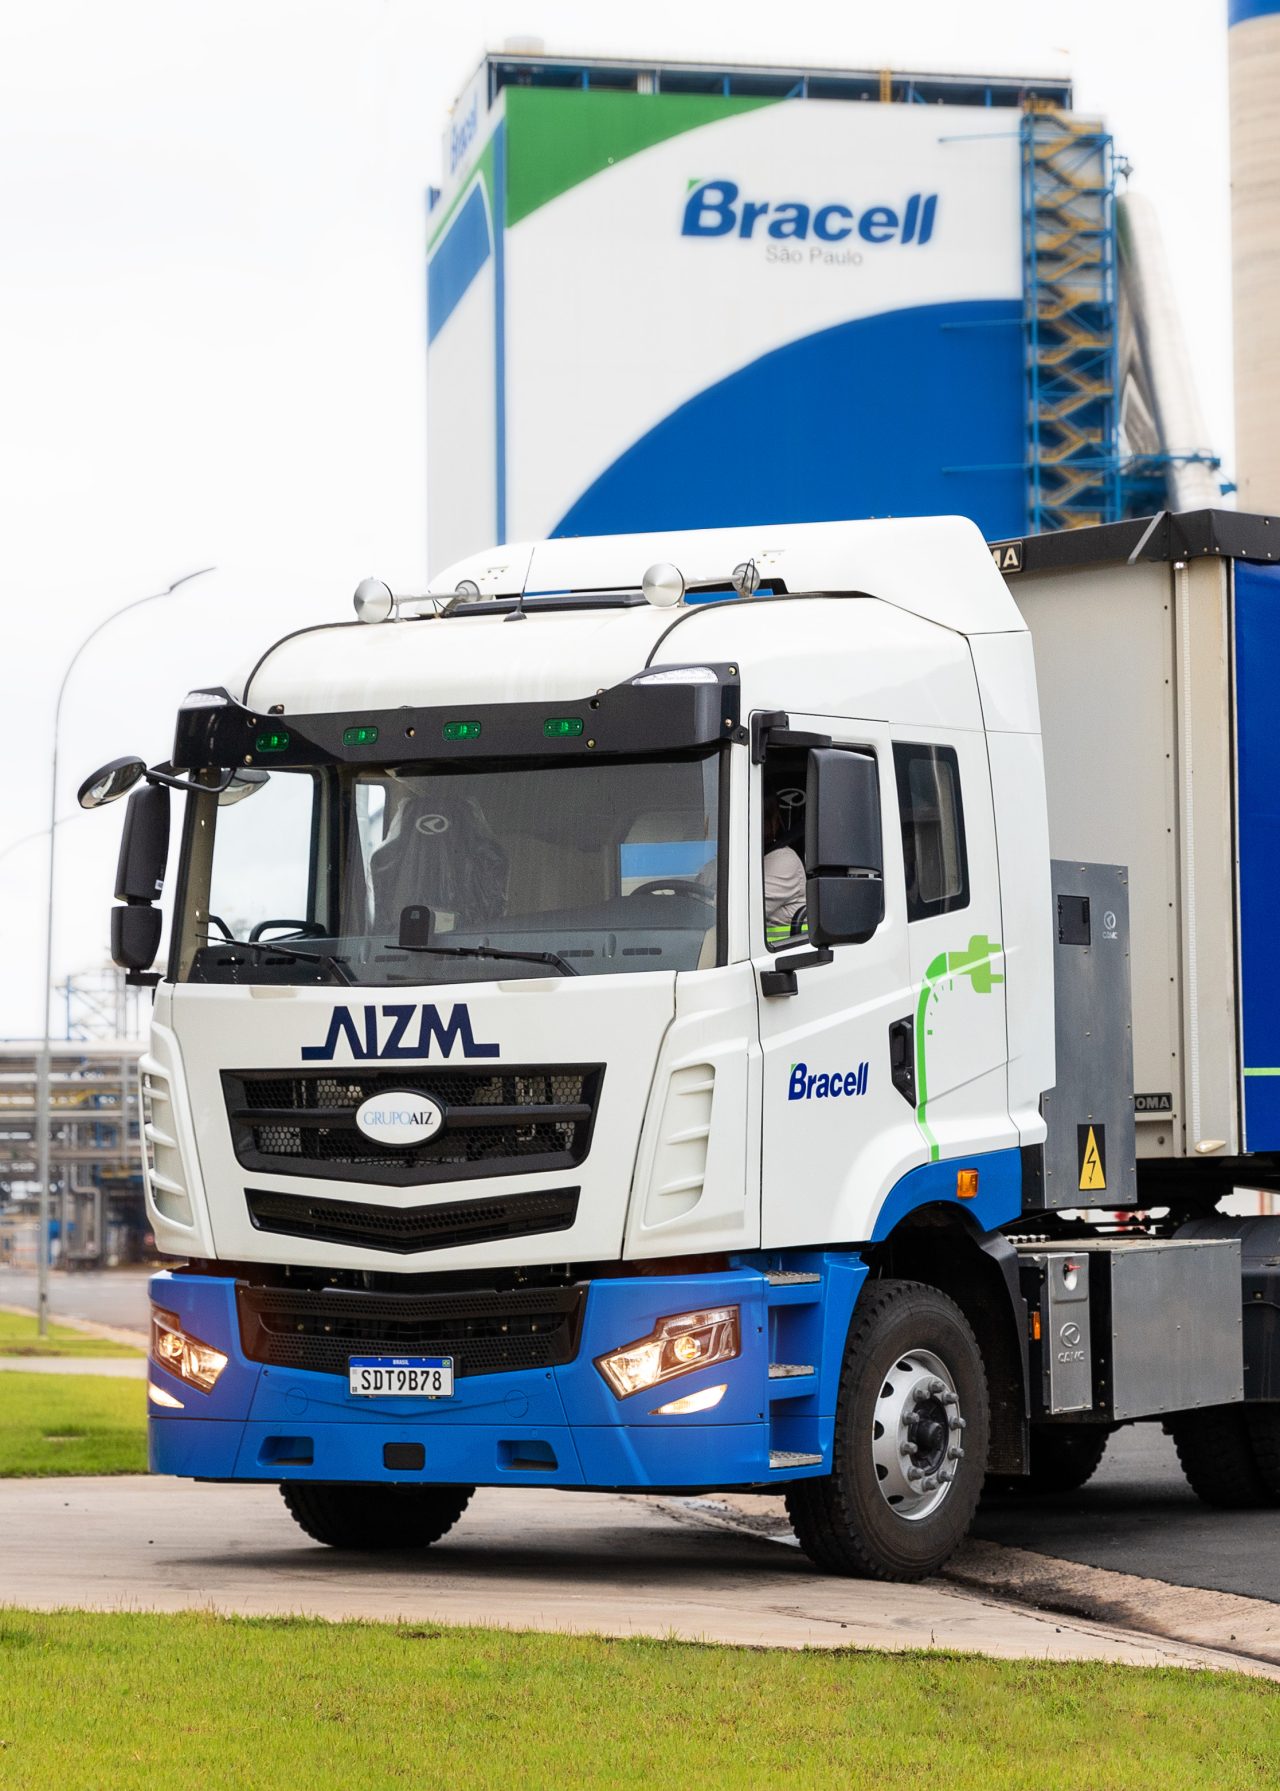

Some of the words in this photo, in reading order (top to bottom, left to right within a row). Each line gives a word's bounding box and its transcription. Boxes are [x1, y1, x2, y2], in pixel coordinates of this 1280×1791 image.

[681, 180, 938, 245] Bracell
[765, 245, 803, 264] São
[808, 246, 865, 267] Paulo
[301, 1003, 500, 1060] AIZM
[788, 1061, 869, 1101] Bracell
[361, 1369, 442, 1391] SDT9B78
